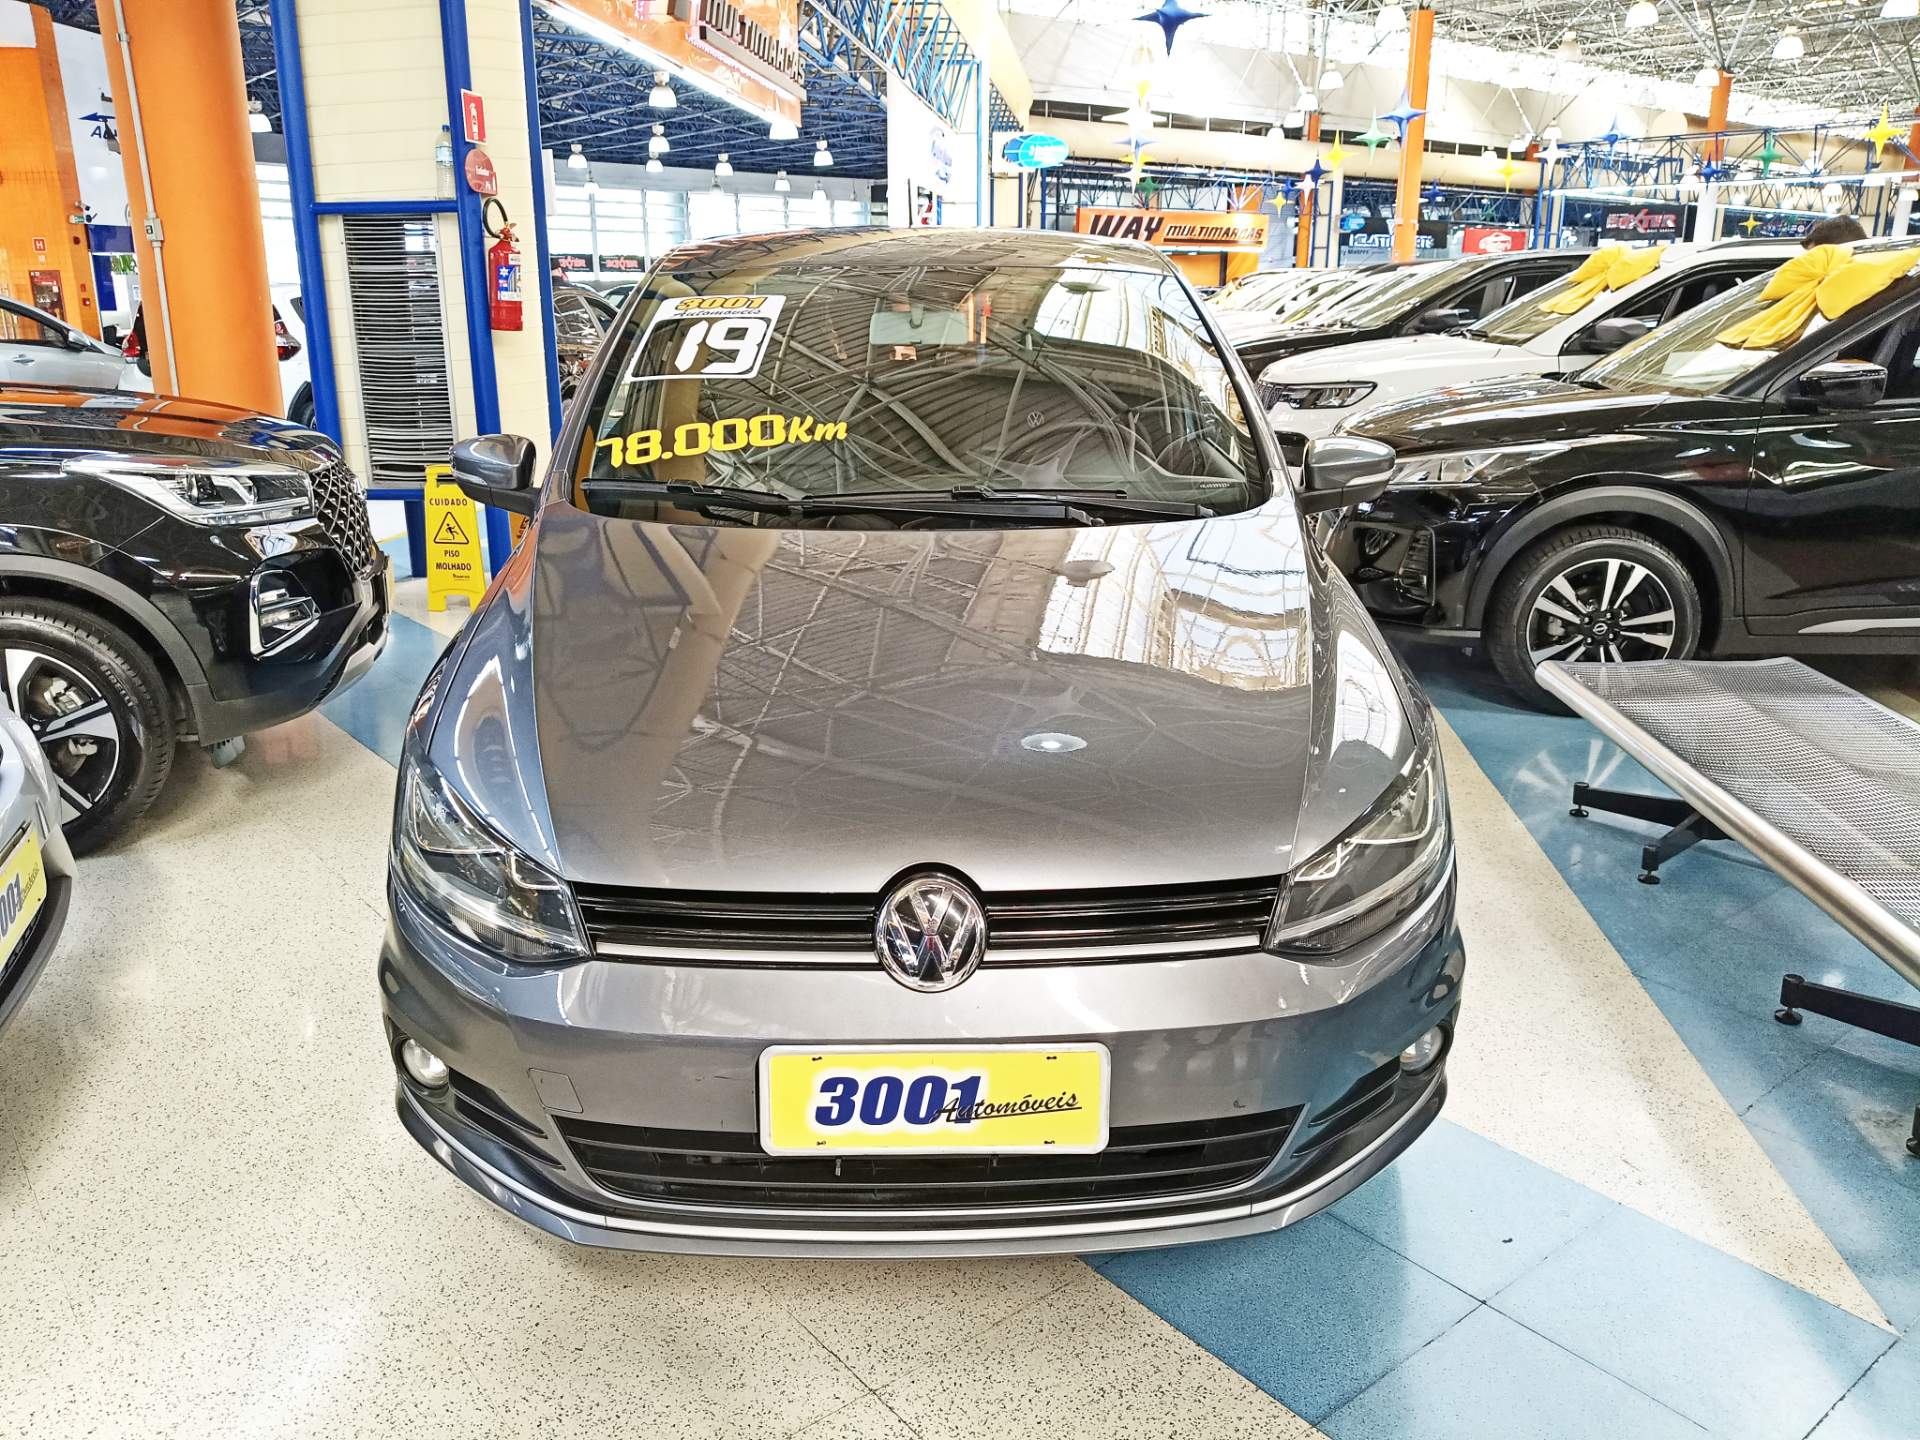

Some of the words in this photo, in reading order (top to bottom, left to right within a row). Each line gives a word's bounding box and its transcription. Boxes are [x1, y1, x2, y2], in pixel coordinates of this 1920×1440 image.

[1089, 214, 1165, 242] WAY
[675, 296, 768, 310] 3001
[674, 318, 768, 374] 19
[429, 498, 468, 506] CUIDADO
[436, 562, 472, 571] MOLHADO
[814, 1075, 982, 1127] 3001
[929, 1091, 1079, 1124] Automóveis
